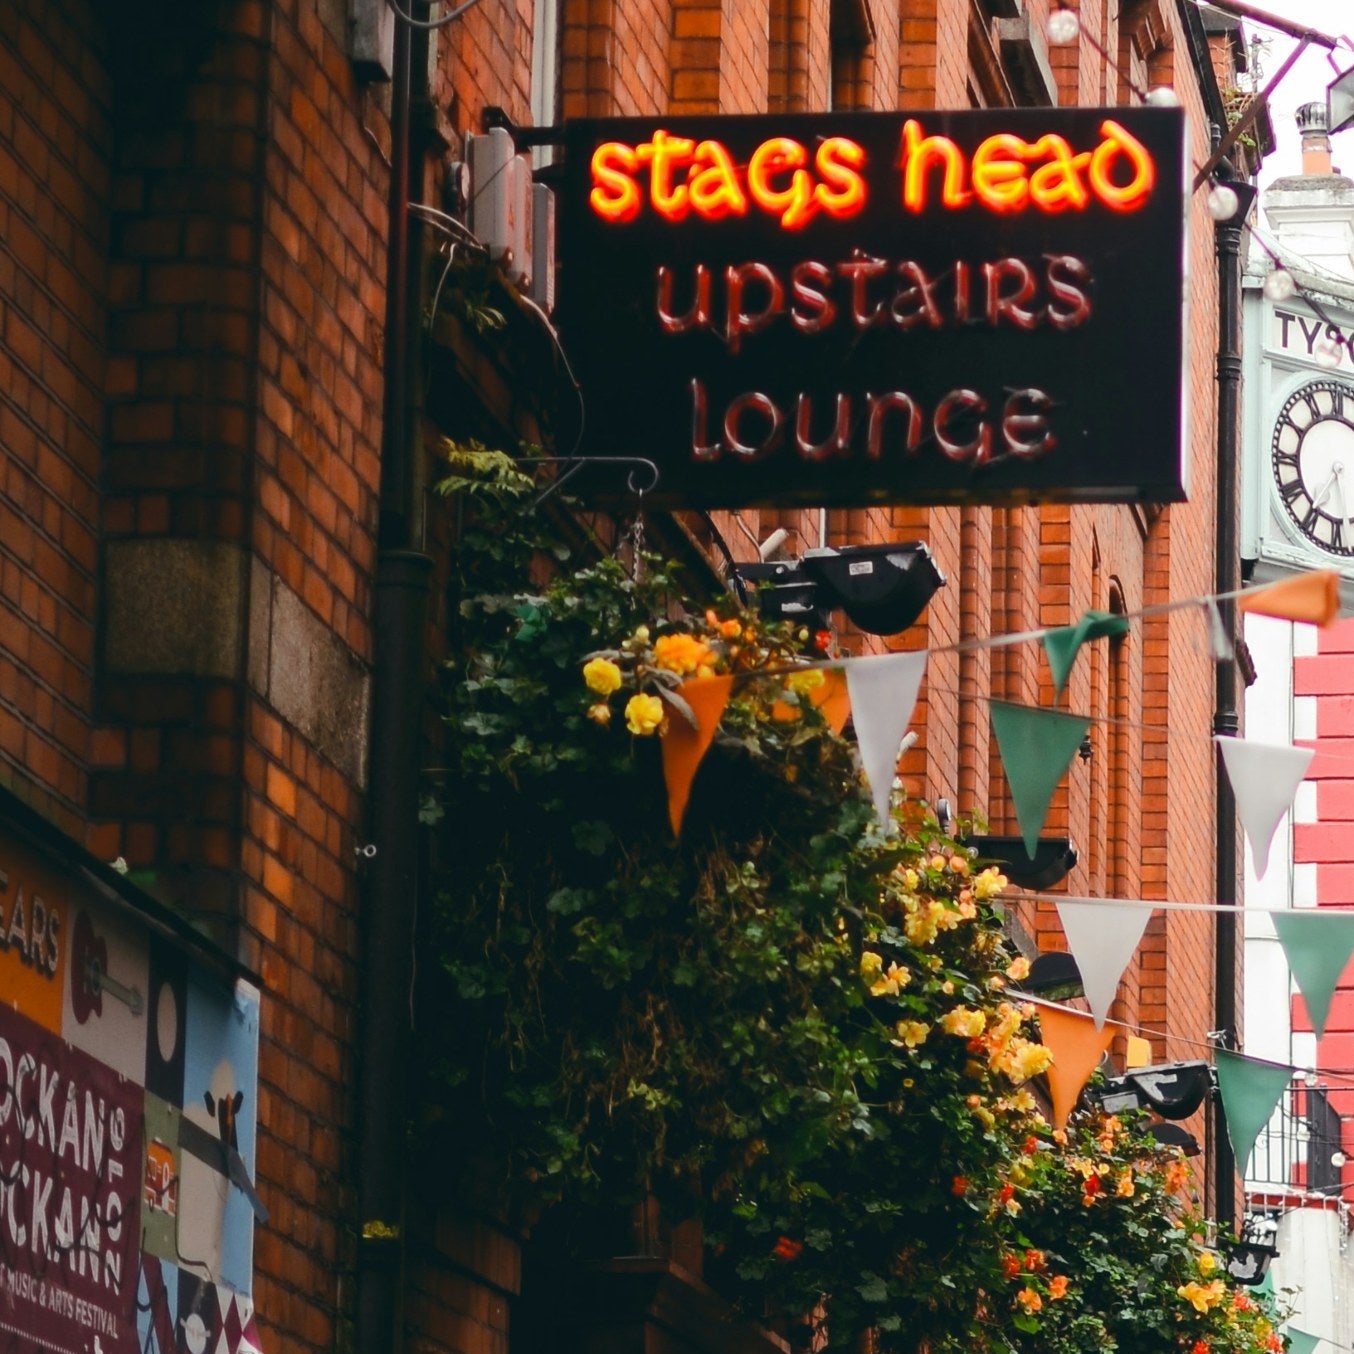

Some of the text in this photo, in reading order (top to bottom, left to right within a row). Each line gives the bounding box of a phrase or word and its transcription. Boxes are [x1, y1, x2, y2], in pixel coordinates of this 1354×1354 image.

[7, 1267, 37, 1303] MUSIC
[48, 1286, 74, 1319] ARTS
[75, 1297, 119, 1339] FESTIVAL
